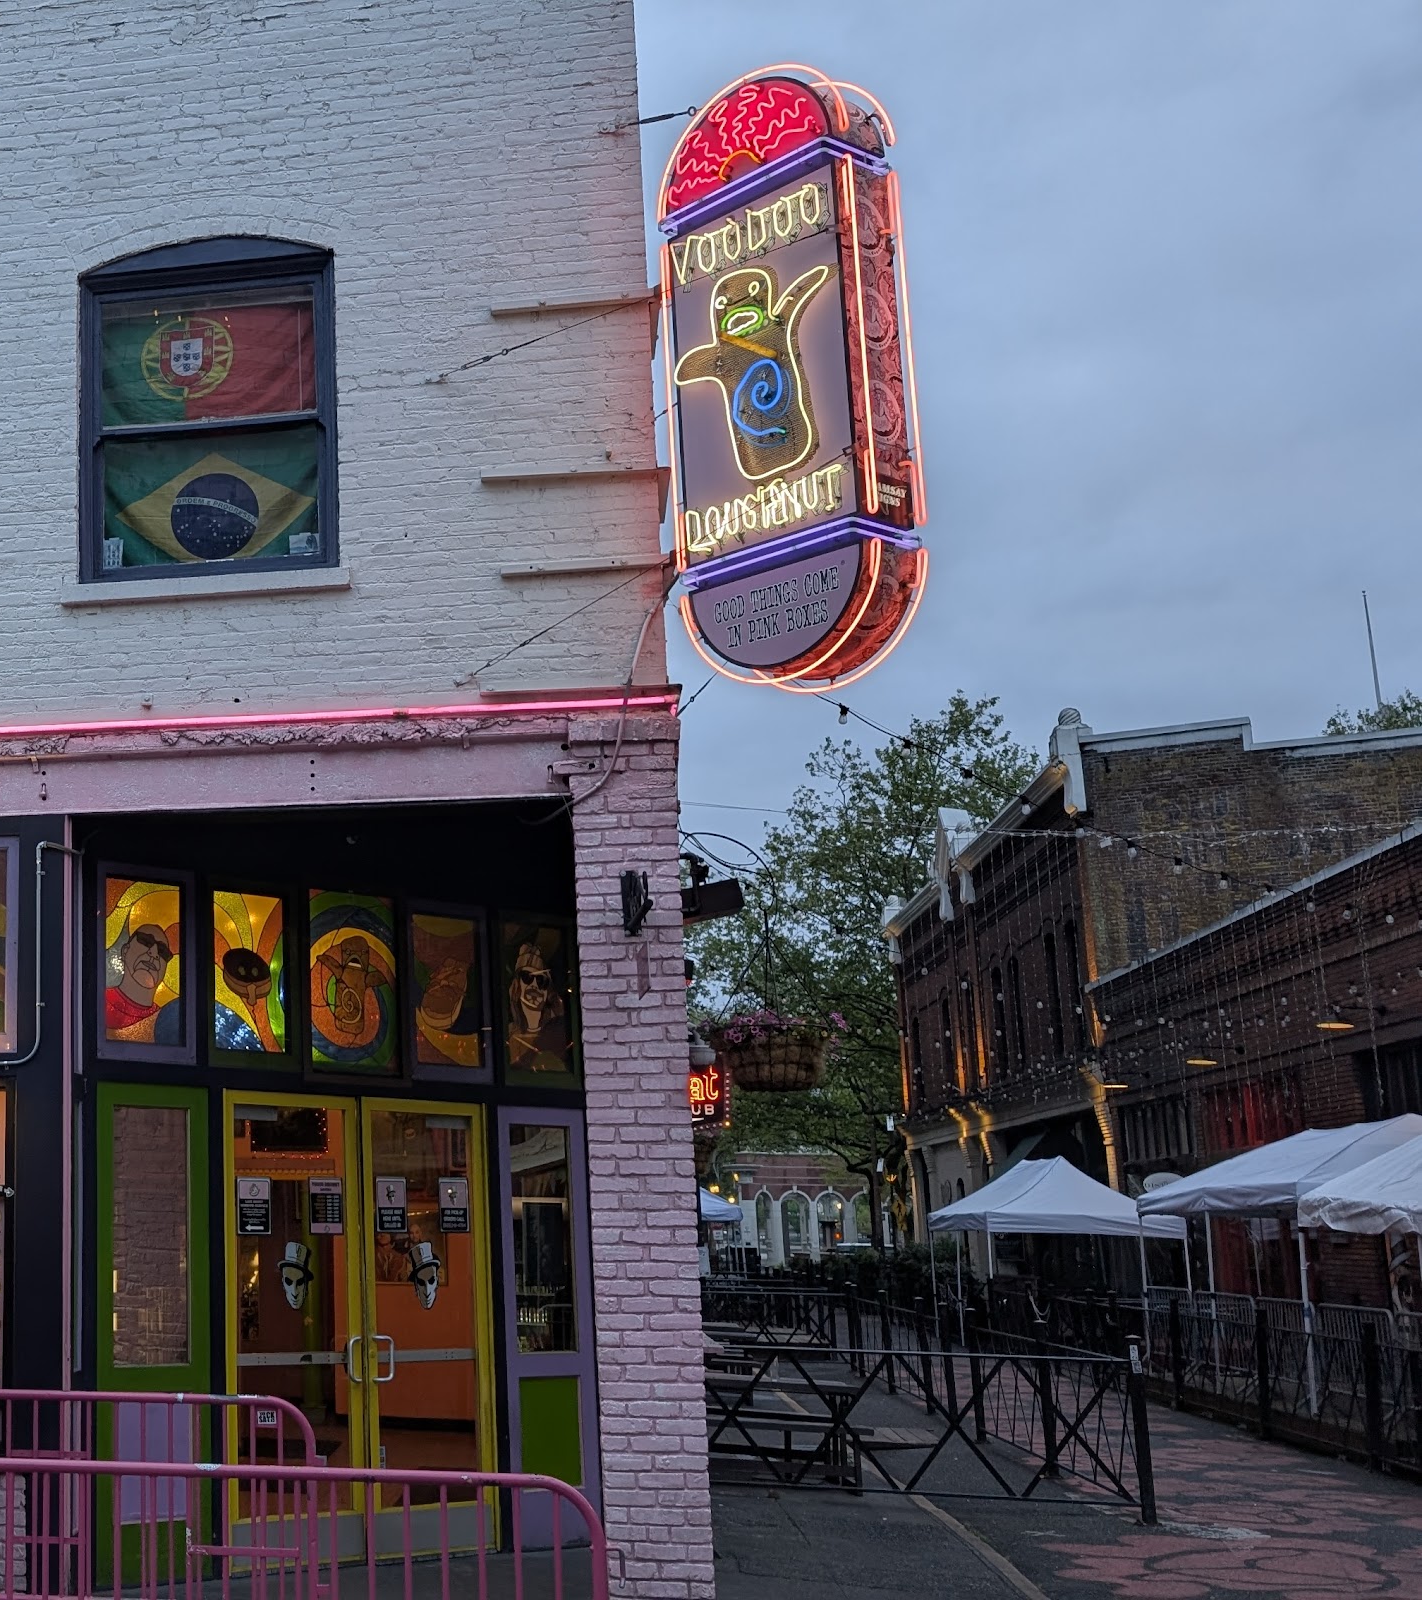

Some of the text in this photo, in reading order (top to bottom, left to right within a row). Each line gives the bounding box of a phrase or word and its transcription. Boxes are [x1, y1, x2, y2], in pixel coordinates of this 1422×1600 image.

[669, 183, 830, 292] VOODOO
[877, 482, 907, 498] AMSAY
[878, 492, 900, 507] IGNS
[212, 500, 257, 524] PROGRESSO
[714, 565, 840, 625] GOOD THINGS COME
[726, 598, 830, 649] IN PINK BOXES
[689, 1065, 719, 1101] at
